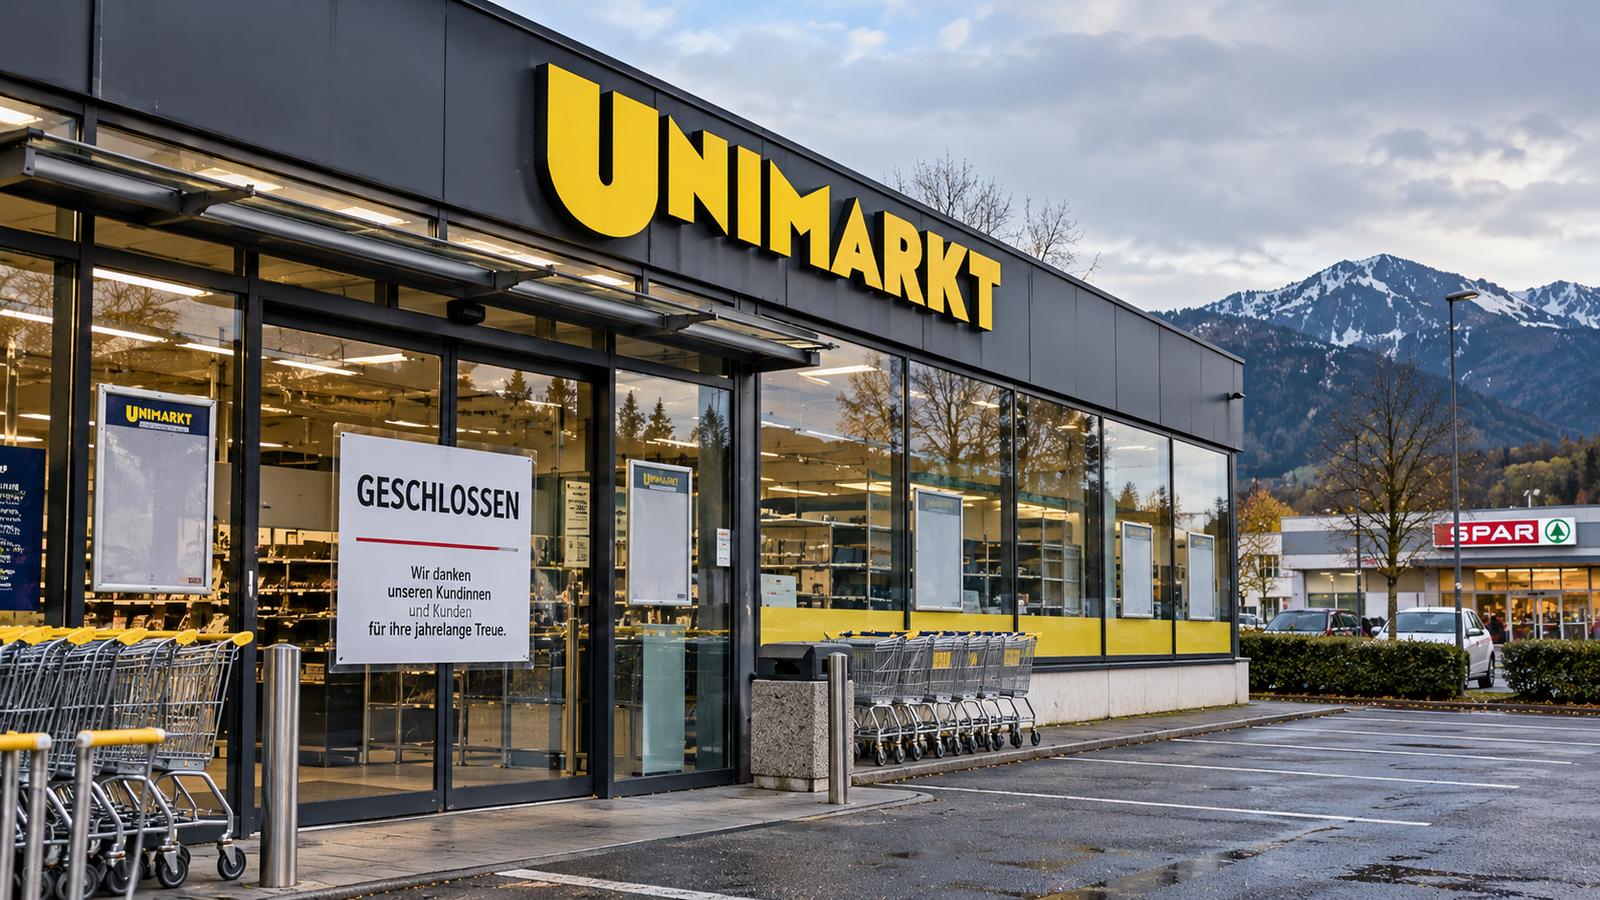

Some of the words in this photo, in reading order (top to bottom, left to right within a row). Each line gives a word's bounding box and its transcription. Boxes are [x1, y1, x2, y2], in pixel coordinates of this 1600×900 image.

[538, 62, 1001, 332] UNIMARKT
[126, 405, 192, 425] UNIMARKT
[357, 474, 519, 520] GESCHLOSSEN
[1450, 524, 1534, 542] SPAR
[411, 566, 430, 580] Wir
[433, 567, 470, 582] danken
[388, 587, 432, 599] unseren
[437, 585, 491, 600] Kundinnen
[409, 604, 429, 617] und
[433, 604, 471, 618] Kunden
[369, 621, 386, 636] für
[390, 622, 411, 636] ihre
[414, 622, 472, 639] jahrelange
[475, 623, 506, 636] Treue.
